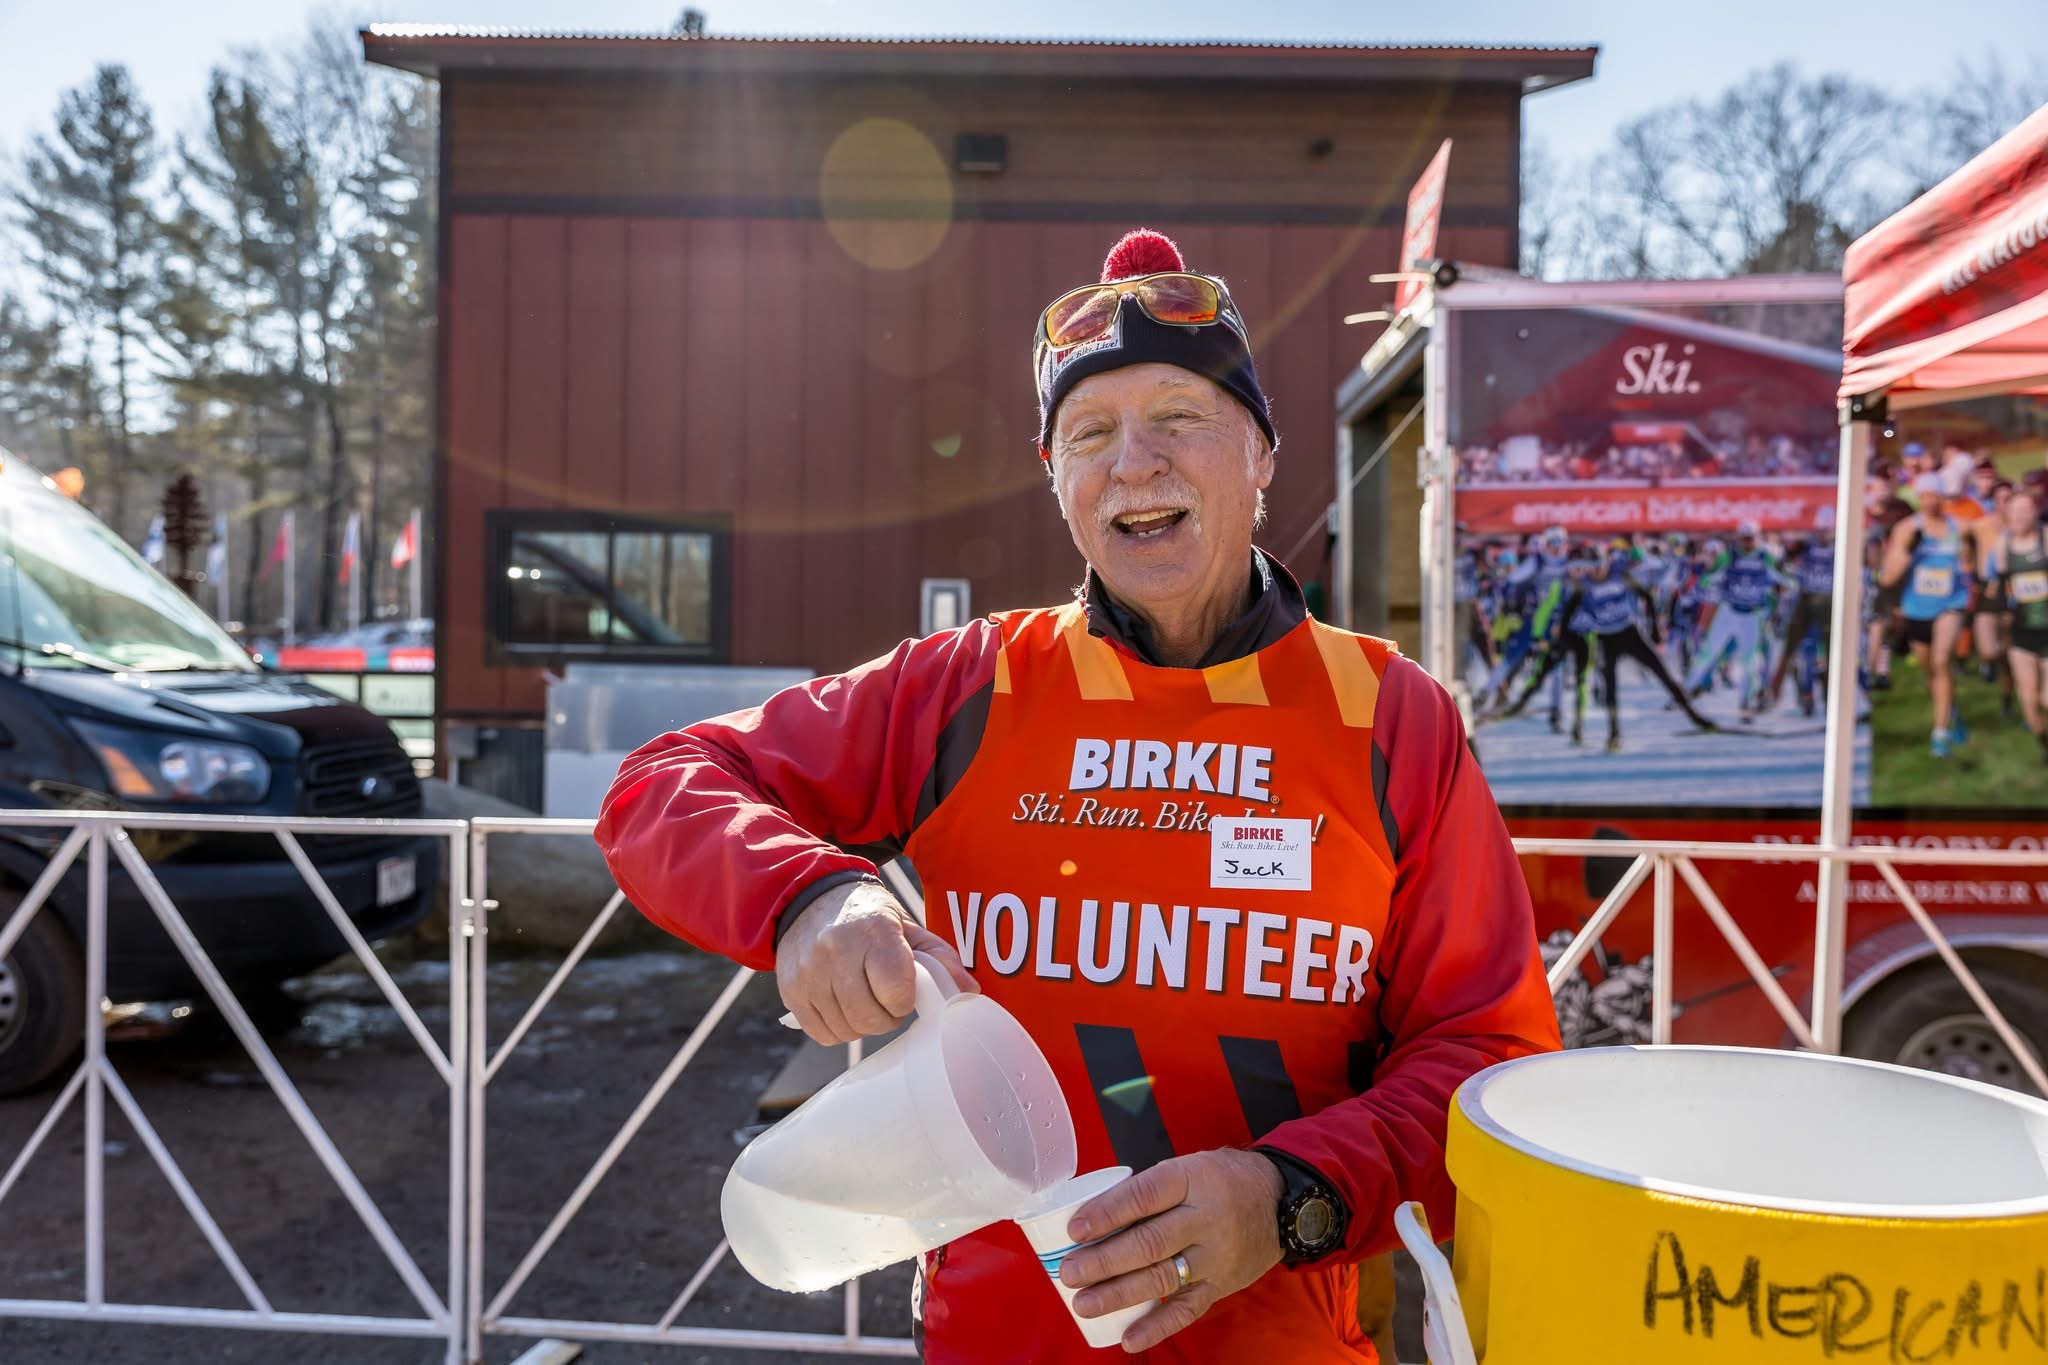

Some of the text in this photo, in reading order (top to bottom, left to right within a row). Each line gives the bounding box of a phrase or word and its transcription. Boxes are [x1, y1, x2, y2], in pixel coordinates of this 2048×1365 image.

[1615, 342, 1701, 394] Ski.
[1512, 499, 1641, 525] american
[1069, 738, 1272, 802] BIRKIE
[1012, 792, 1065, 823] Ski.
[1072, 797, 1146, 828] Run.
[1220, 841, 1299, 852] Ski. Run. Bike. Live!
[1233, 827, 1284, 842] BIRKIE
[947, 891, 1374, 1003] VOLUNTEER
[1643, 1229, 2048, 1365] AMERICAN
